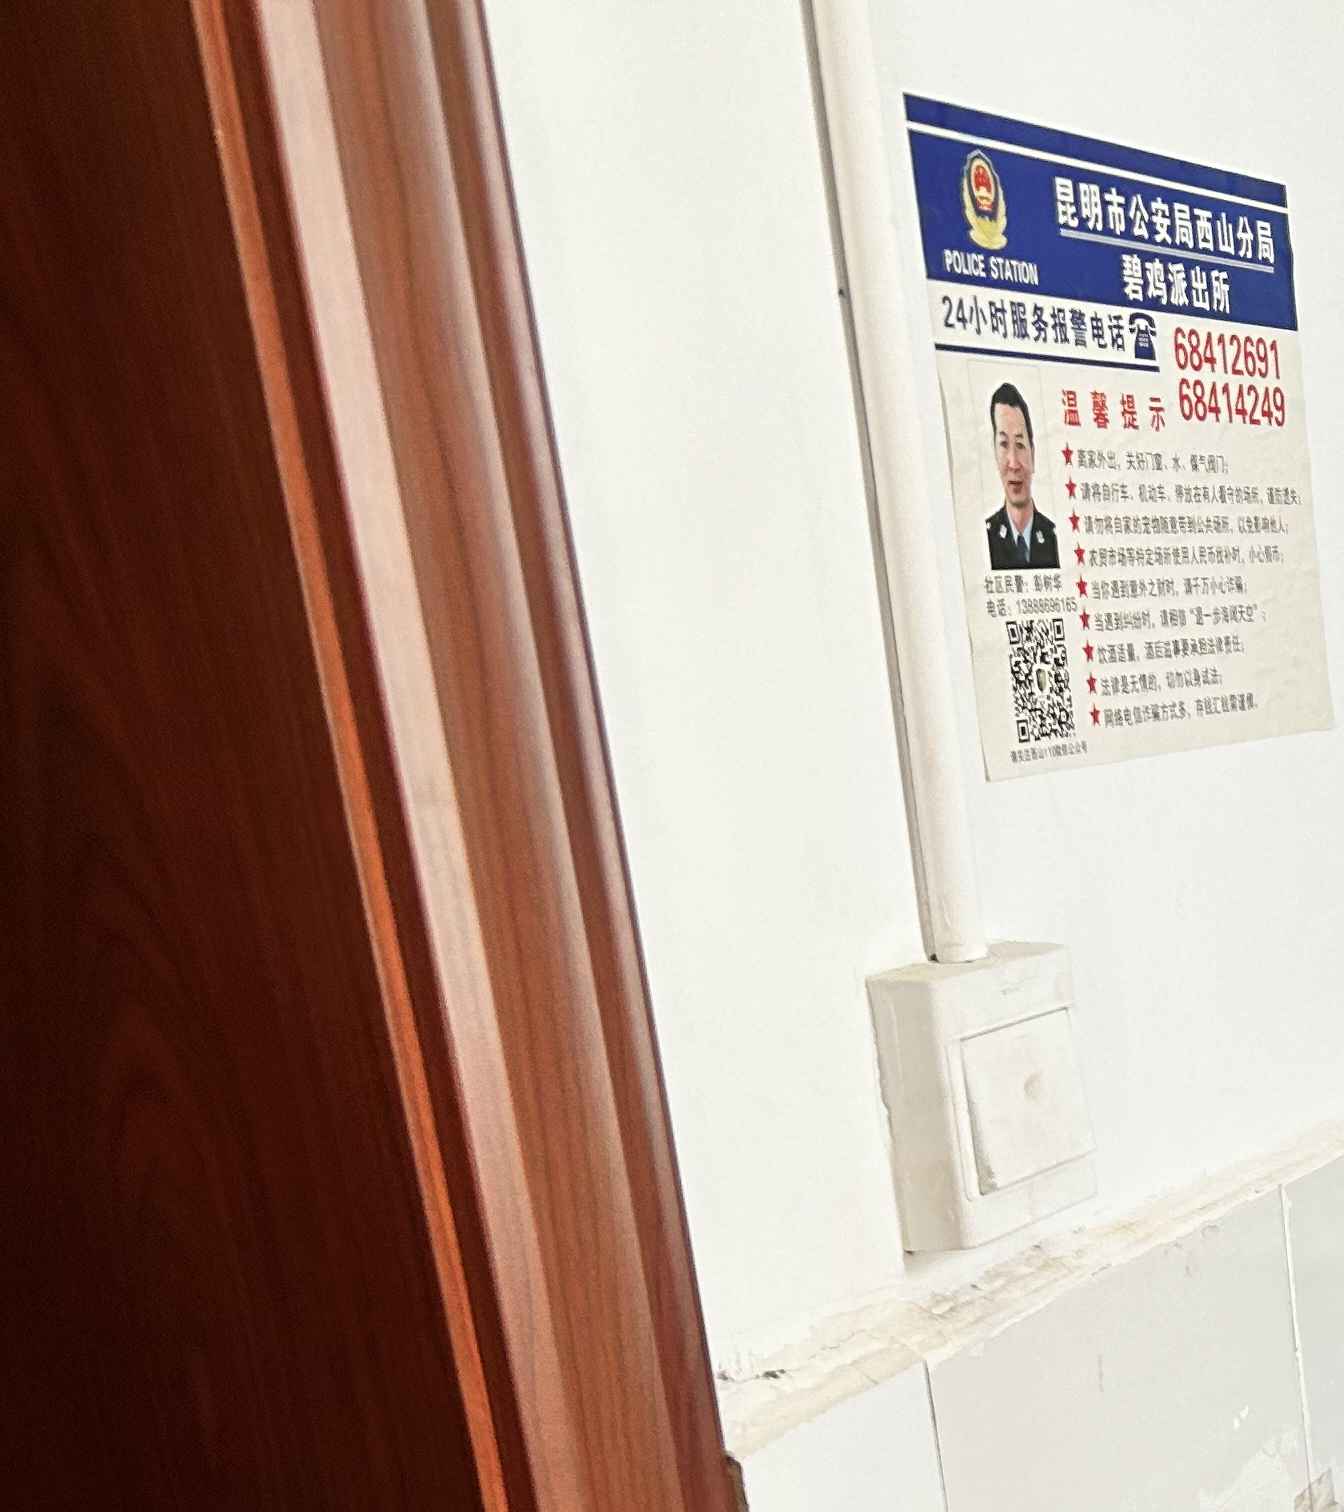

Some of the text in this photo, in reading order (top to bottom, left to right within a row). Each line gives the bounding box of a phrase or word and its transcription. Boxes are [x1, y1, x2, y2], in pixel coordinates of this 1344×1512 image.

[1054, 176, 1275, 264] 昆明市公安局西山分局
[943, 248, 1039, 286] POLICE STATION
[1121, 254, 1230, 314] 碧鸡派出所
[941, 295, 1126, 352] 24小时服务报警电话
[1174, 326, 1281, 380] 68412691
[1061, 388, 1166, 432] 温馨提示
[1179, 378, 1286, 427] 68414249
